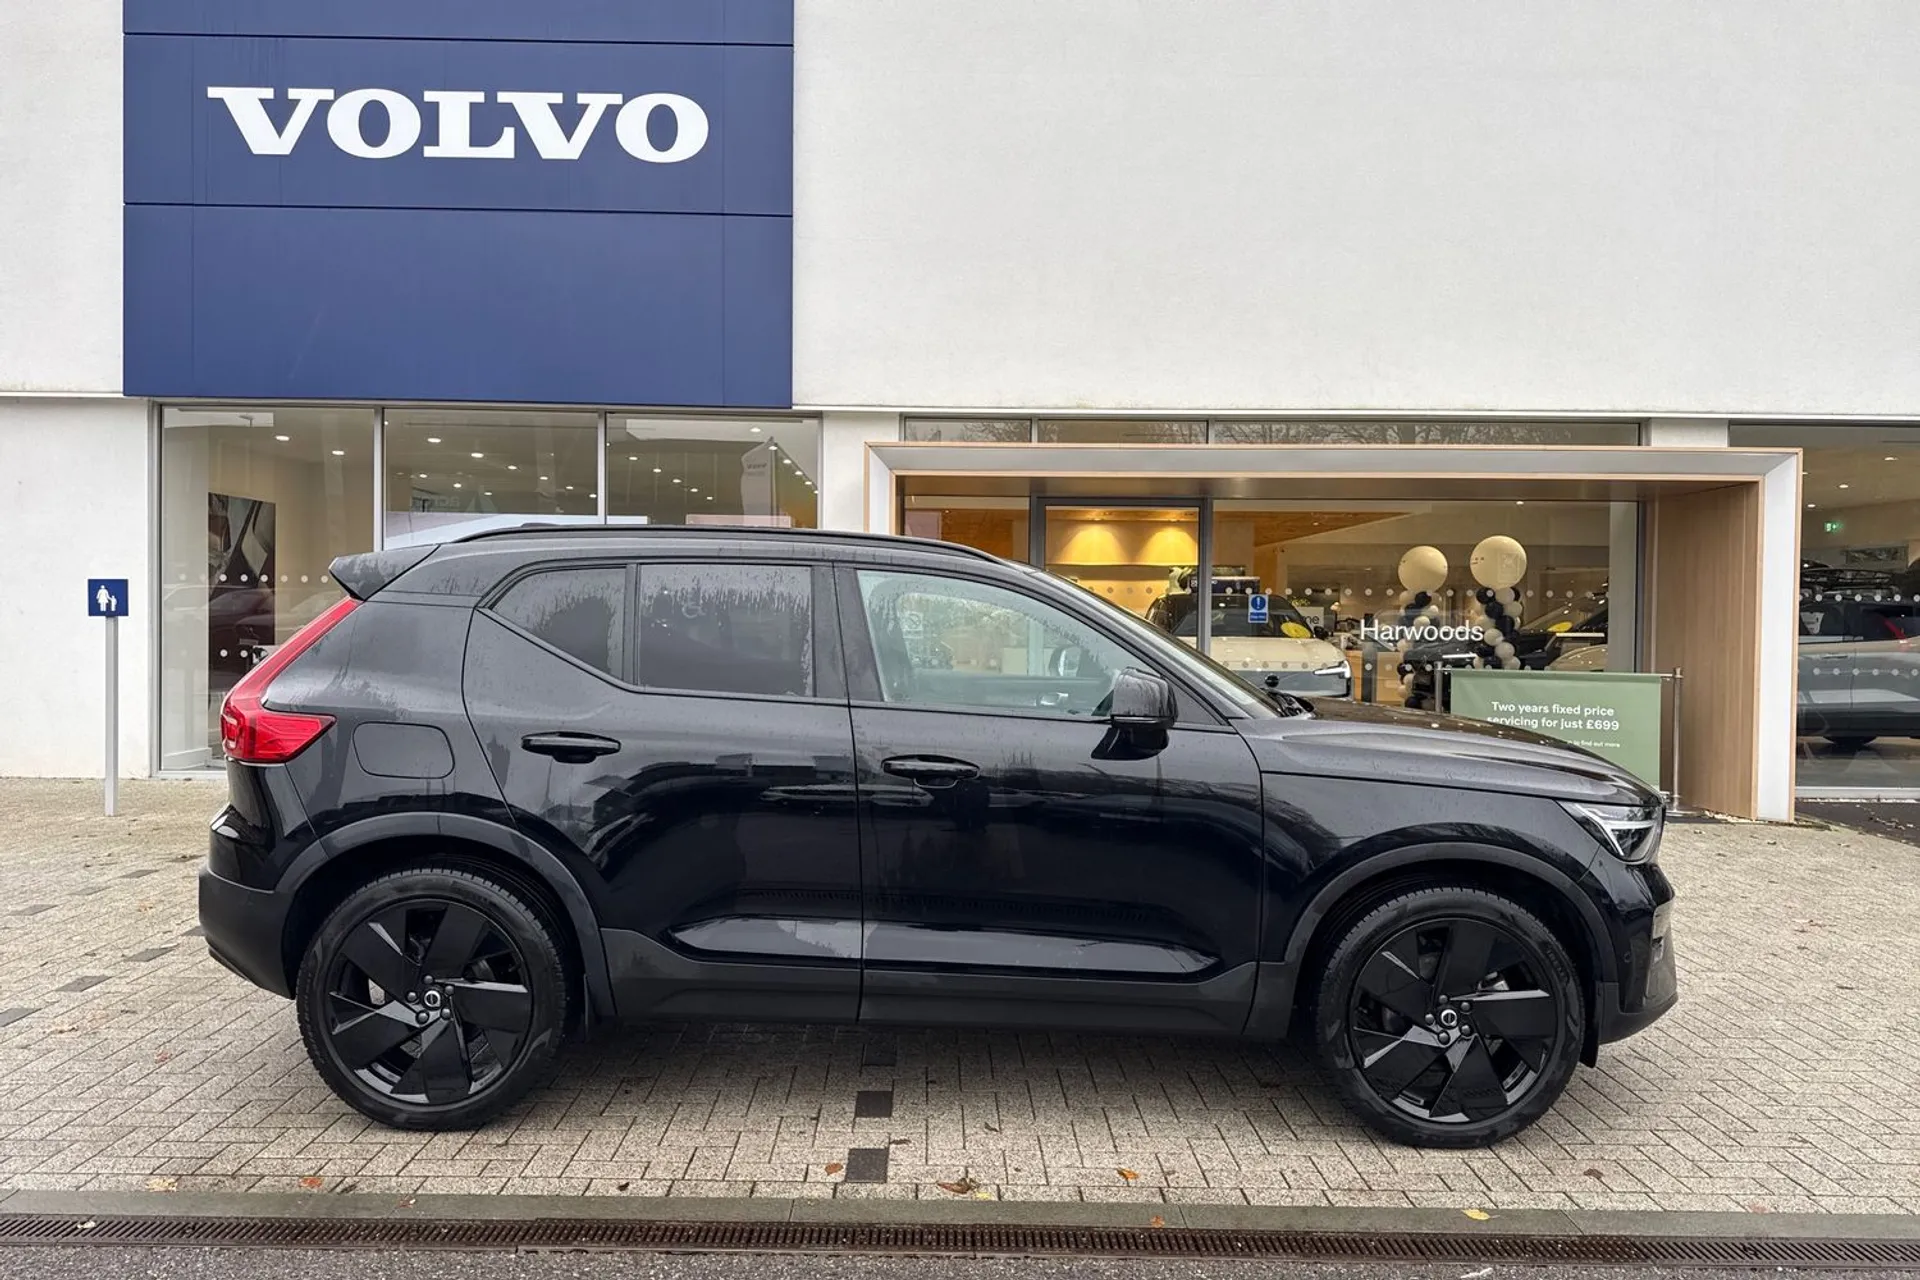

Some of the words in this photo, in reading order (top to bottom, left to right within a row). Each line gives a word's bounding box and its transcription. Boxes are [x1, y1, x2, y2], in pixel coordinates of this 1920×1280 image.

[207, 86, 709, 163] VOLVO
[1360, 619, 1484, 641] Harwoods
[1491, 701, 1516, 712] Two
[1518, 703, 1550, 714] years
[1552, 703, 1581, 715] fixed
[1584, 706, 1615, 717] price
[1541, 717, 1558, 728] for
[1560, 718, 1583, 730] just
[1586, 719, 1620, 731] £699
[1581, 739, 1593, 747] find
